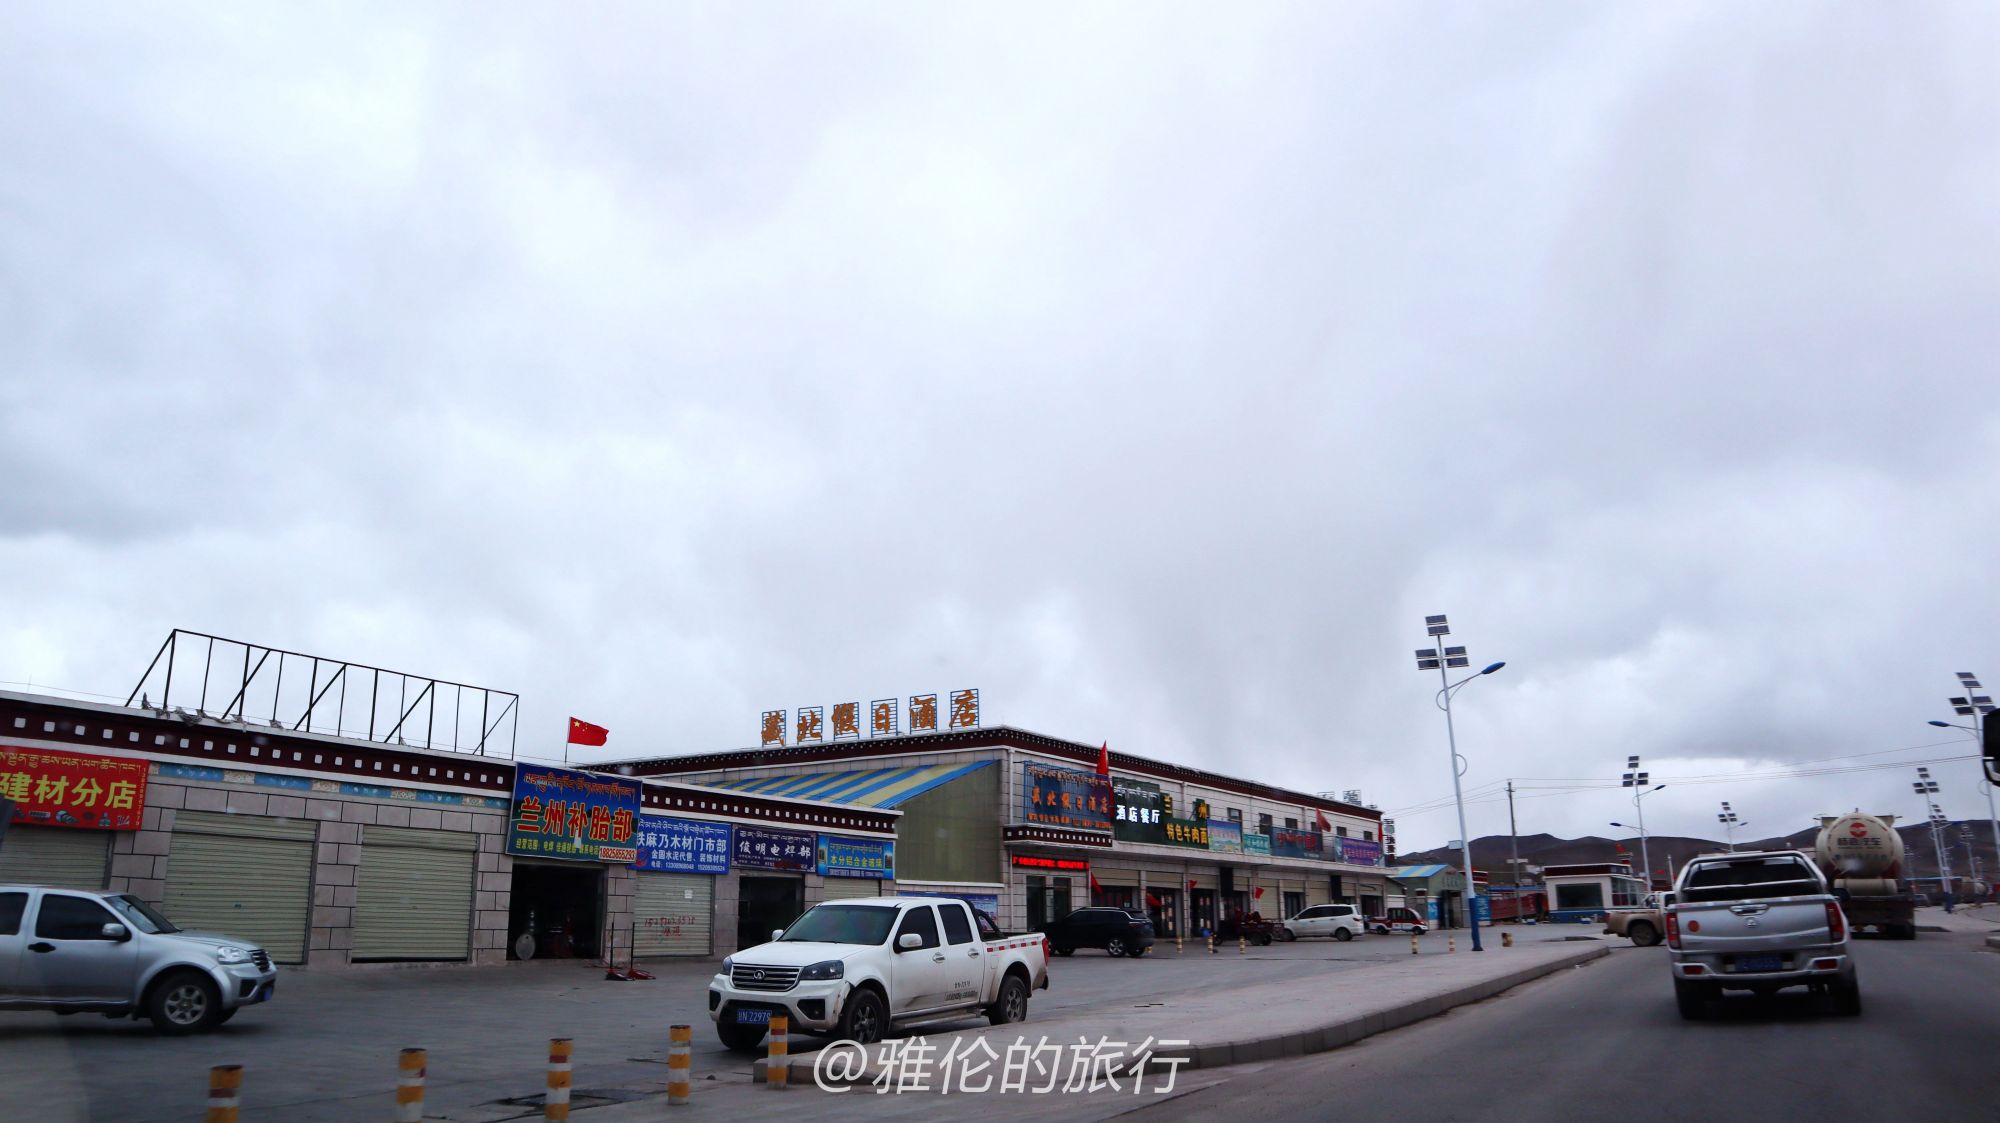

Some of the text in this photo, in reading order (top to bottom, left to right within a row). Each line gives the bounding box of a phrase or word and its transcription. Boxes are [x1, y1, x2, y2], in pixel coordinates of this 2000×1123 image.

[761, 689, 977, 746] 藏北假日酒店
[0, 772, 137, 809] 建材分店
[516, 795, 633, 843] 兰州补胎部
[1116, 804, 1160, 824] 酒店餐厅
[1166, 822, 1208, 845] 特色牛肉面
